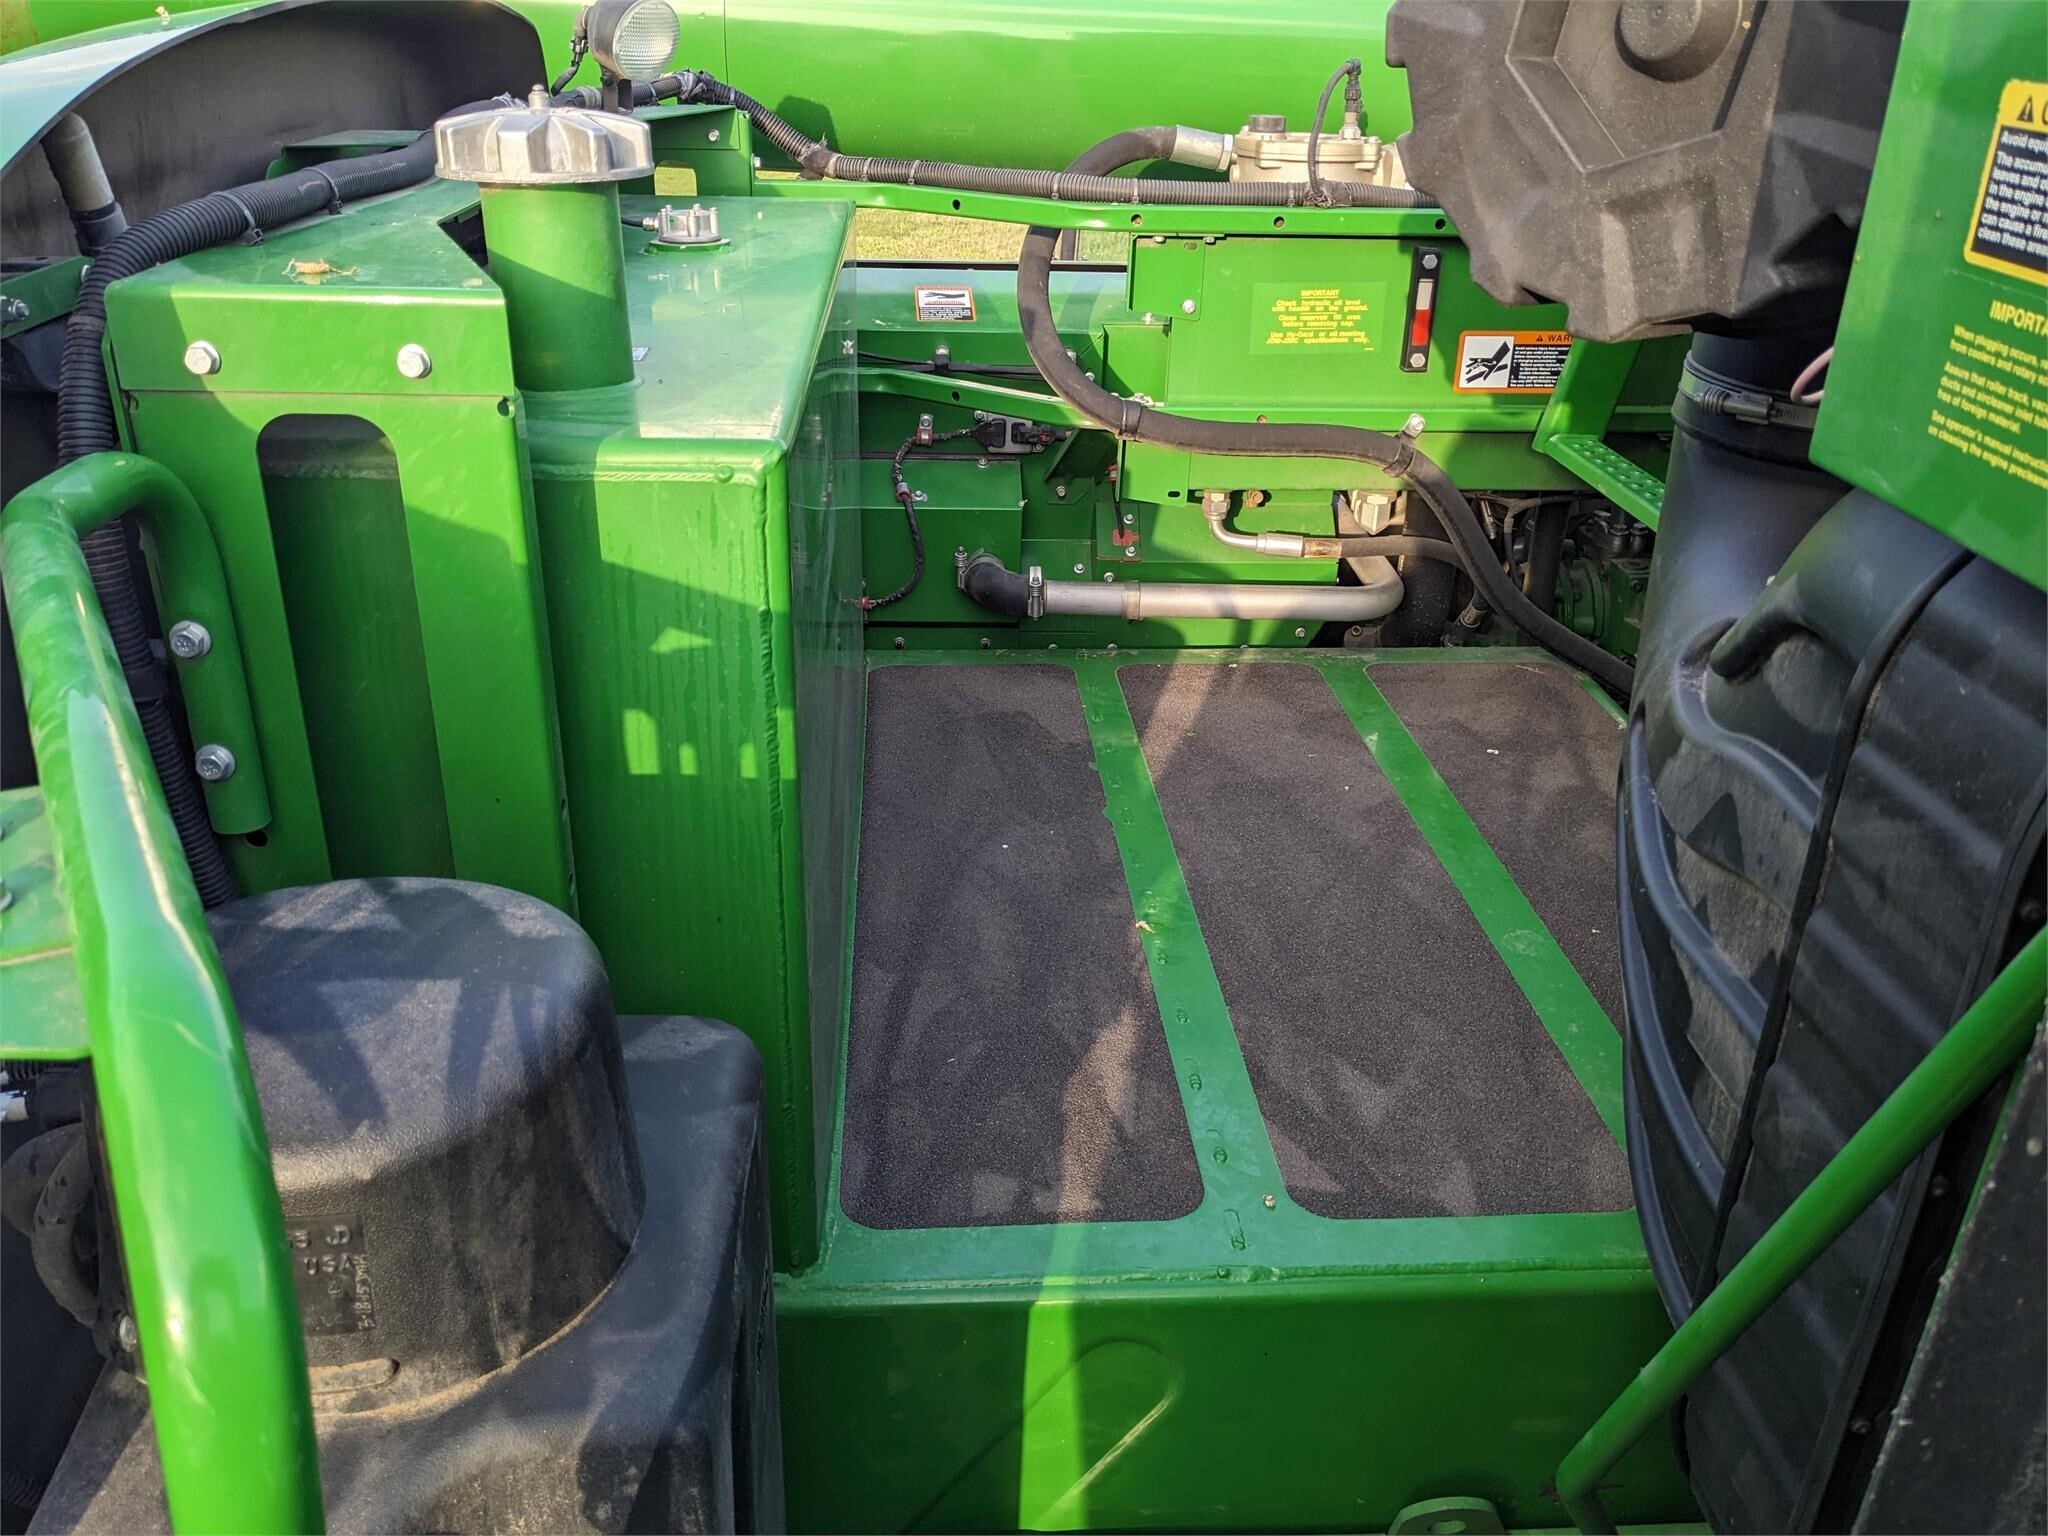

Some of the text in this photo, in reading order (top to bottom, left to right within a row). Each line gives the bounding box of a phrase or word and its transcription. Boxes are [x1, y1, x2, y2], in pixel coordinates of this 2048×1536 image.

[2001, 131, 2028, 149] Avoid
[1997, 151, 2014, 168] The
[1992, 167, 2020, 185] leaves
[2021, 175, 2040, 190] and
[1988, 181, 2045, 208] in the engine
[1984, 197, 2000, 213] the
[2000, 202, 2031, 219] engine
[2031, 210, 2042, 223] or
[1981, 213, 1998, 228] can
[1998, 217, 2025, 235] cause
[2025, 224, 2033, 237] a
[1977, 226, 2001, 244] clean
[2001, 232, 2027, 252] these
[1301, 289, 1340, 297] IMPORTANT
[1953, 323, 1975, 342] When
[1974, 334, 2009, 358] plugging
[1949, 338, 1968, 356] from
[1967, 348, 1996, 367] coolers
[1996, 358, 2013, 373] and
[1940, 376, 1961, 393] ducts
[1960, 385, 1977, 399] and
[1943, 360, 1970, 381] Assure
[1969, 371, 1986, 387] that
[1985, 379, 2007, 397] roller
[1936, 387, 1952, 405] free
[1951, 395, 1961, 407] of
[1960, 398, 1988, 421] foreign
[1931, 409, 1946, 426] See
[1927, 425, 1938, 438] on
[1937, 430, 1969, 454] cleaning
[1968, 442, 1983, 459] the
[303, 1252, 357, 1277] USA
